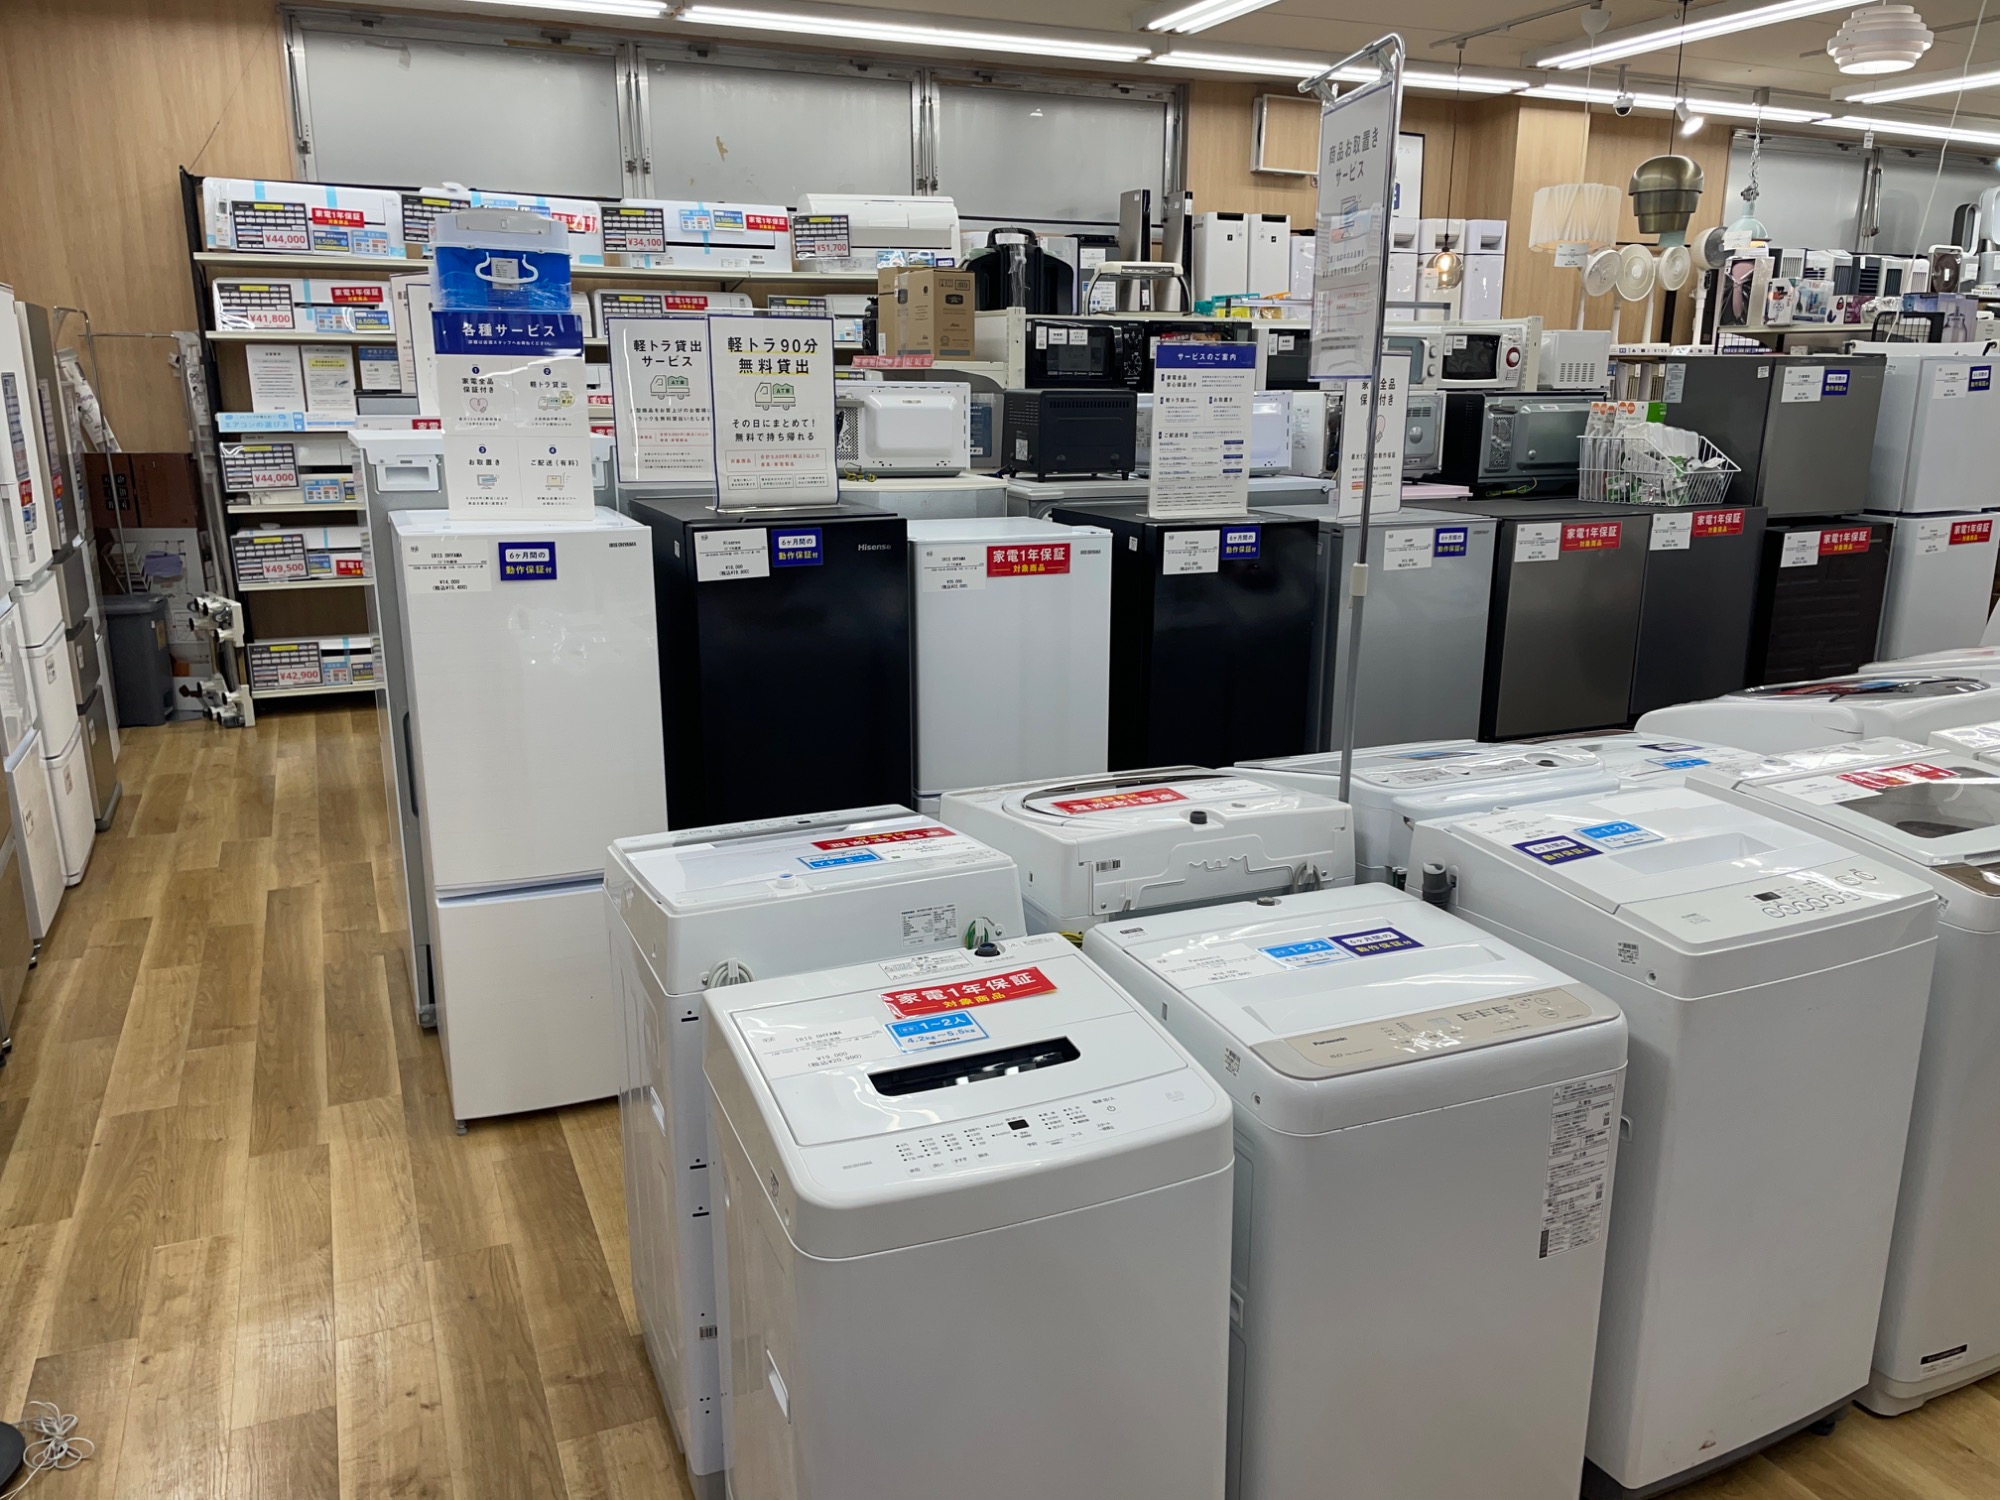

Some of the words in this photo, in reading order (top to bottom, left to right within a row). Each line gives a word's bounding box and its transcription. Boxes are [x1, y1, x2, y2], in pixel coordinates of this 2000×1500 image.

[1328, 126, 1379, 165] 商品お取置き
[1335, 161, 1364, 187] サービス
[314, 208, 362, 222] 家電1年保証
[748, 216, 787, 226] 家電1年保証
[265, 234, 306, 244] ¥44,000
[628, 238, 662, 248] ¥34,100
[816, 242, 848, 253] ¥51,700
[333, 288, 380, 297] 家電1年保証
[667, 297, 706, 306] 家電1年保証
[249, 314, 291, 324] ¥41,800
[462, 322, 556, 338] 各種サービス
[633, 339, 702, 353] 軽トラ貸出
[728, 336, 818, 354] 軽トラ90分
[641, 354, 693, 368] サービス
[1177, 352, 1238, 362] サービスのご案内
[738, 358, 810, 375] 無料貸出
[463, 386, 495, 394] 保証付き
[530, 381, 568, 389] 軽トラ貸出
[1360, 394, 1394, 407] 保付き
[732, 419, 816, 428] その日にまとめて！
[735, 432, 815, 443] 無料で持ち帰れる
[254, 473, 295, 485] ¥44,000
[1696, 512, 1742, 526] 家電1年保証
[1565, 525, 1617, 540] 家電1年保証
[1954, 522, 1990, 536] 家電1年保証
[781, 537, 813, 546] 6ヶ月間の
[1823, 530, 1867, 544] 家電1年保証
[858, 543, 892, 552] Hisense
[509, 551, 546, 560] 6ヶ月間の
[778, 550, 819, 560] 動作保証付
[992, 546, 1066, 564] 家電1年保証
[264, 562, 305, 574] ¥49,500
[505, 564, 553, 575] 動作保証付
[1013, 564, 1046, 573] 対象商品
[280, 669, 319, 681] ¥42,900
[1348, 932, 1392, 946] 6ヶ月間の
[1354, 939, 1413, 954] 動作保証付
[894, 971, 1037, 1006] 家電1年保証
[942, 991, 1007, 1009] 対象商品
[794, 1036, 815, 1047] IRIS
[815, 1033, 843, 1043] OHYAMA
[1312, 1036, 1349, 1048] Panasonic
